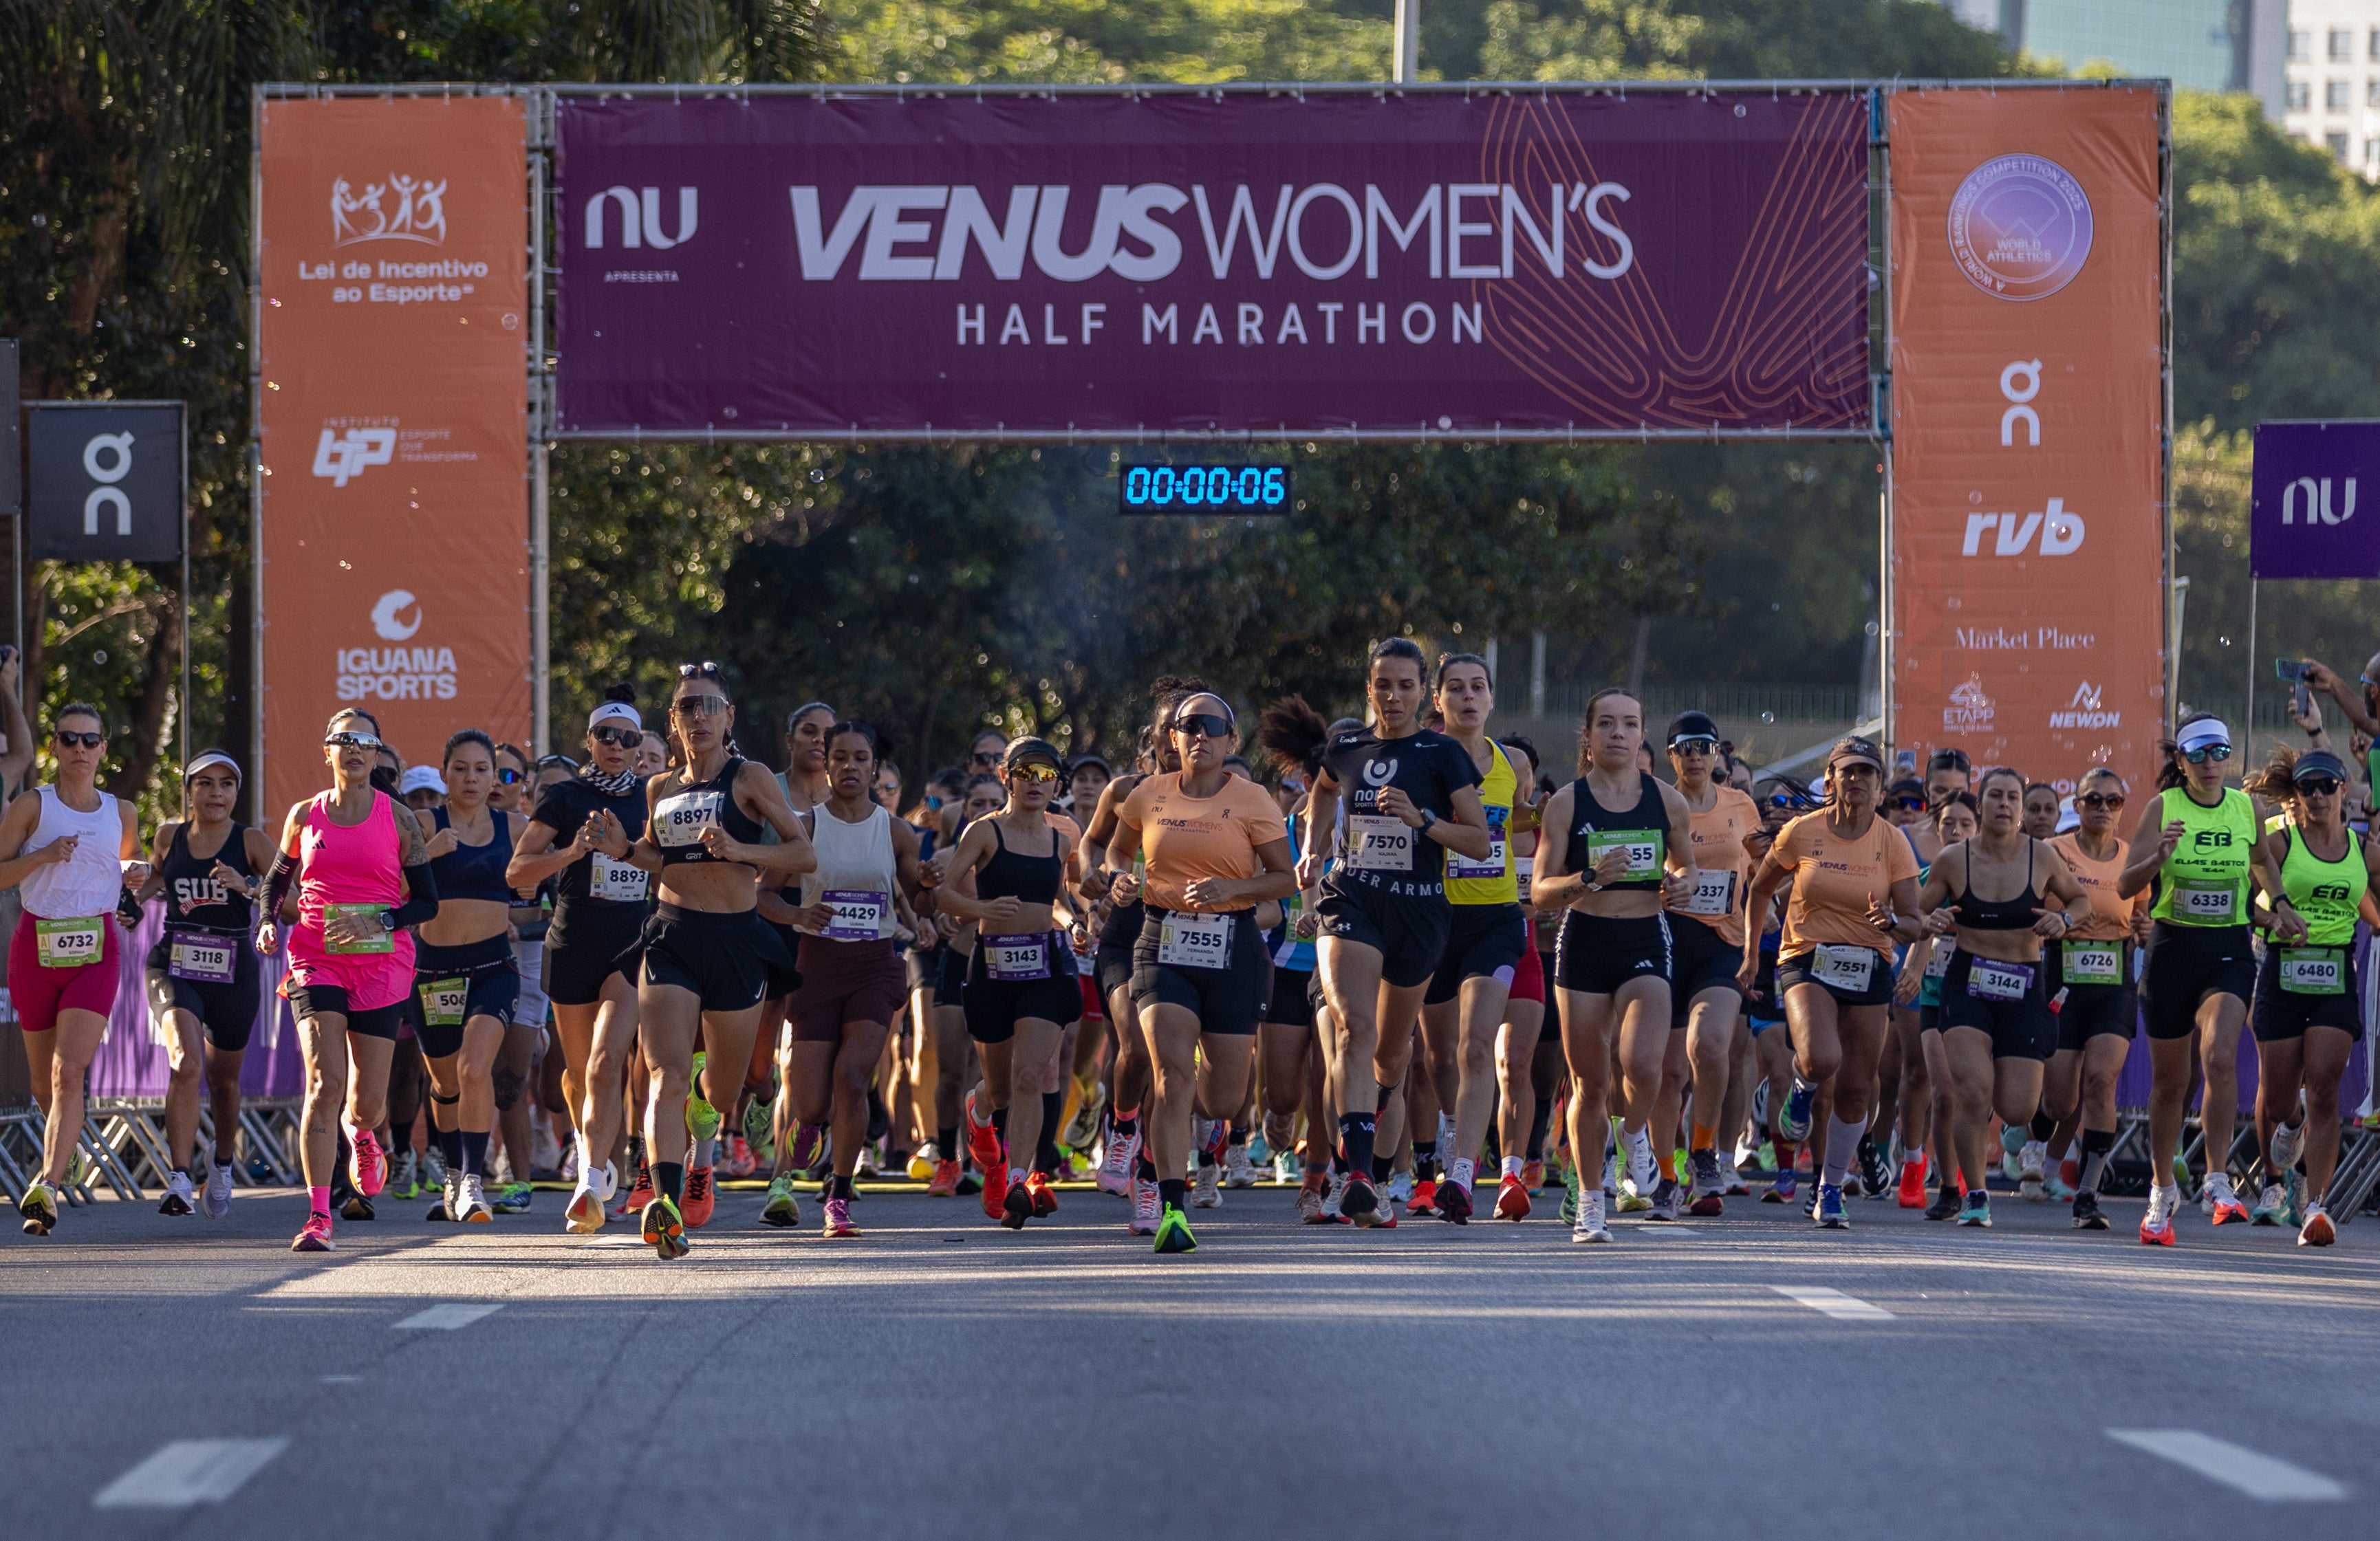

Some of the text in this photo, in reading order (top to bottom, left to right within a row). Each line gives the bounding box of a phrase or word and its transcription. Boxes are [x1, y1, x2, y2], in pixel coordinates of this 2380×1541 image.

[789, 181, 1633, 281] VENUS WOMEN'S
[1998, 239, 2042, 252] WORLD
[1987, 251, 2052, 263] ATHLETICS
[299, 259, 488, 280] Lei de Incentivo
[604, 270, 680, 283] APRESENTA
[333, 287, 363, 303] ao
[957, 301, 1482, 345] HALF MARATHON
[323, 417, 400, 427] INSTITUTO
[400, 429, 451, 439] ESPORTE
[1126, 467, 1284, 504] 00:00:06
[1962, 497, 2086, 556] rvb
[1956, 626, 2095, 649] Market Place
[337, 647, 457, 674] IGUANA
[336, 673, 457, 700] SPORTS
[1944, 708, 1994, 723] ETAPP
[2049, 711, 2121, 728] NEWON
[658, 813, 664, 826] A
[673, 808, 713, 825] 8897
[1157, 818, 1187, 827] VENUS
[1352, 833, 1358, 846] A
[1367, 835, 1407, 849] 7570
[1593, 849, 1599, 862] A
[1332, 857, 1381, 888] NDER
[1819, 861, 1847, 871] VENUS
[594, 868, 601, 881] A
[610, 870, 646, 883] 8893
[174, 877, 229, 903] SUB
[2192, 895, 2228, 906] 6338
[839, 906, 876, 920] 4429
[2322, 909, 2356, 918] BASTOS
[1163, 928, 1170, 941] A
[1180, 930, 1222, 948] 7555
[41, 936, 47, 948] A
[58, 935, 93, 948] 6732
[175, 947, 180, 959] A
[192, 950, 223, 964] 3118
[988, 950, 995, 961] A
[1004, 950, 1038, 963] 3143
[2066, 954, 2071, 965] A
[1815, 957, 1822, 968] A
[1833, 961, 1867, 973] 7551
[2081, 954, 2113, 967] 6726
[2284, 963, 2289, 974] C
[2297, 964, 2335, 976] 6480
[1972, 970, 1978, 981] A
[1988, 974, 2020, 990] 3144
